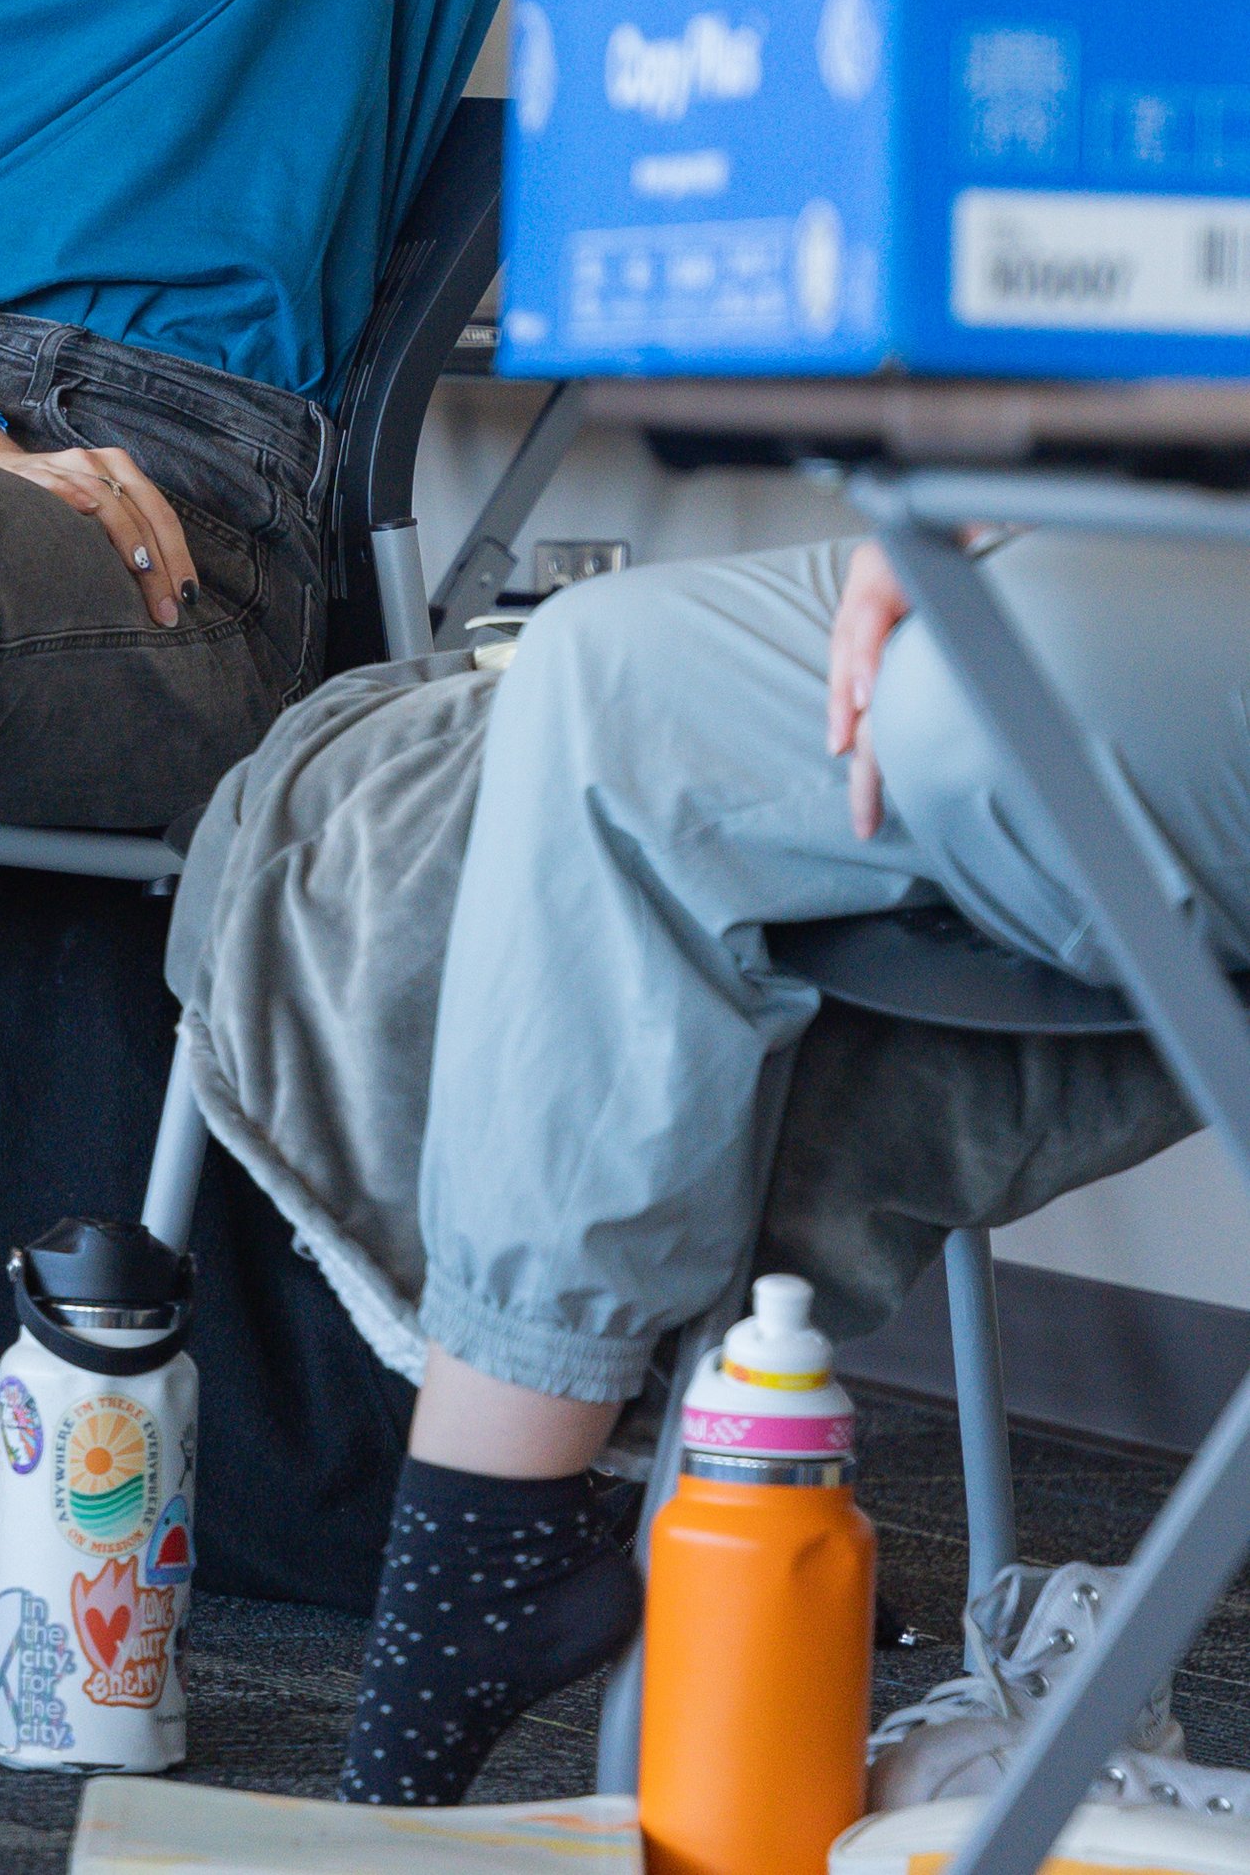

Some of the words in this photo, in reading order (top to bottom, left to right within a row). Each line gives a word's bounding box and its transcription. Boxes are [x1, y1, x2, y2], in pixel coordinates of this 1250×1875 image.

[97, 1396, 145, 1421] THERE
[54, 1417, 75, 1522] ANYWHERE
[143, 1421, 159, 1525] EVERYWHERE
[67, 1528, 86, 1546] ON
[91, 1529, 145, 1553] MISSION
[23, 1593, 45, 1619] in
[22, 1619, 64, 1644] the
[21, 1668, 57, 1692] for
[21, 1695, 62, 1719] the
